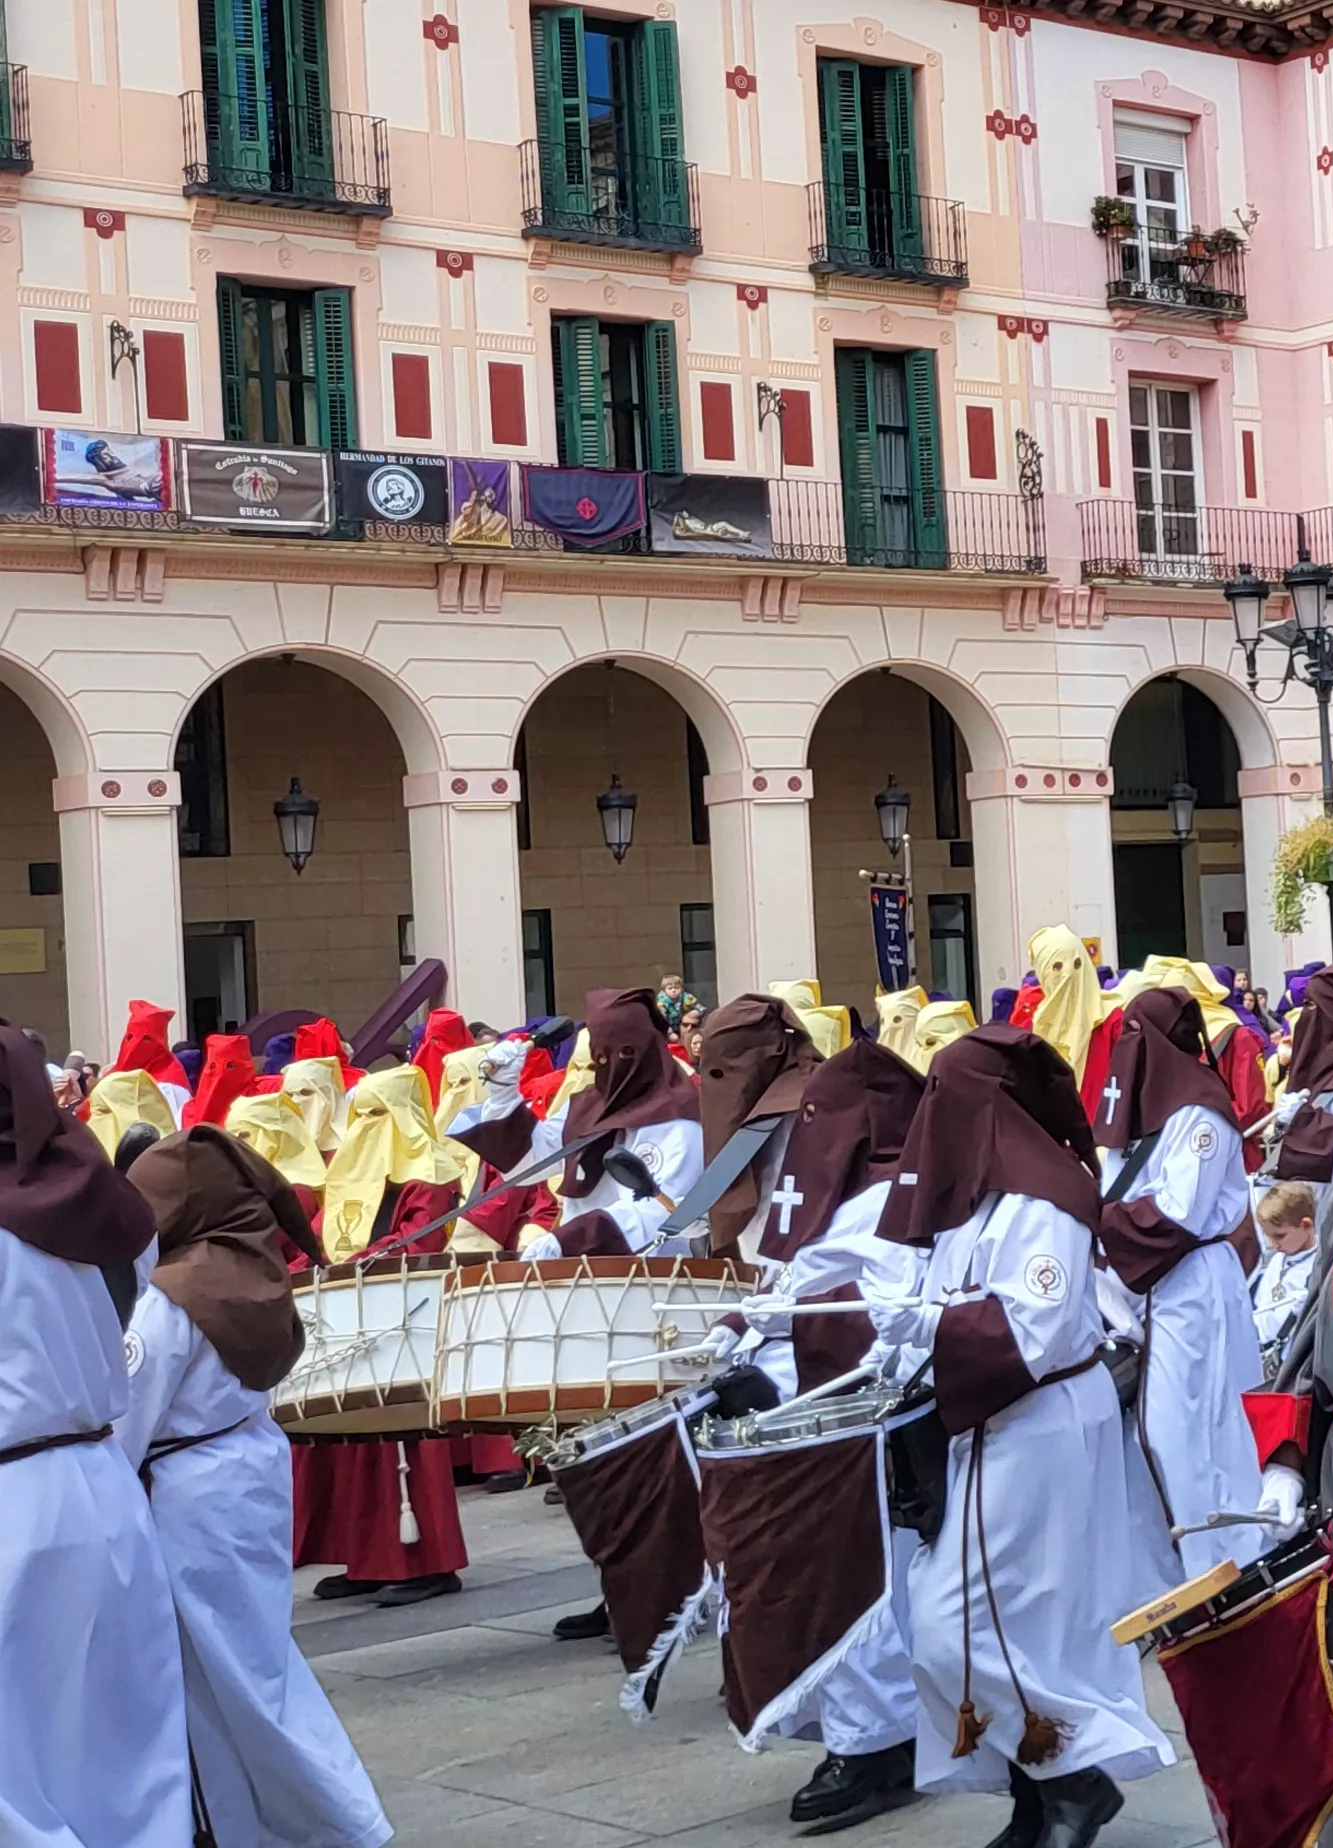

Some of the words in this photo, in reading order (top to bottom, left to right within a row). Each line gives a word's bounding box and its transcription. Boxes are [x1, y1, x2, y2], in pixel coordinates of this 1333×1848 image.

[340, 452, 385, 464] HERMANDAD
[387, 455, 398, 464] DE
[400, 456, 414, 465] LOS
[416, 456, 446, 467] GITANOS
